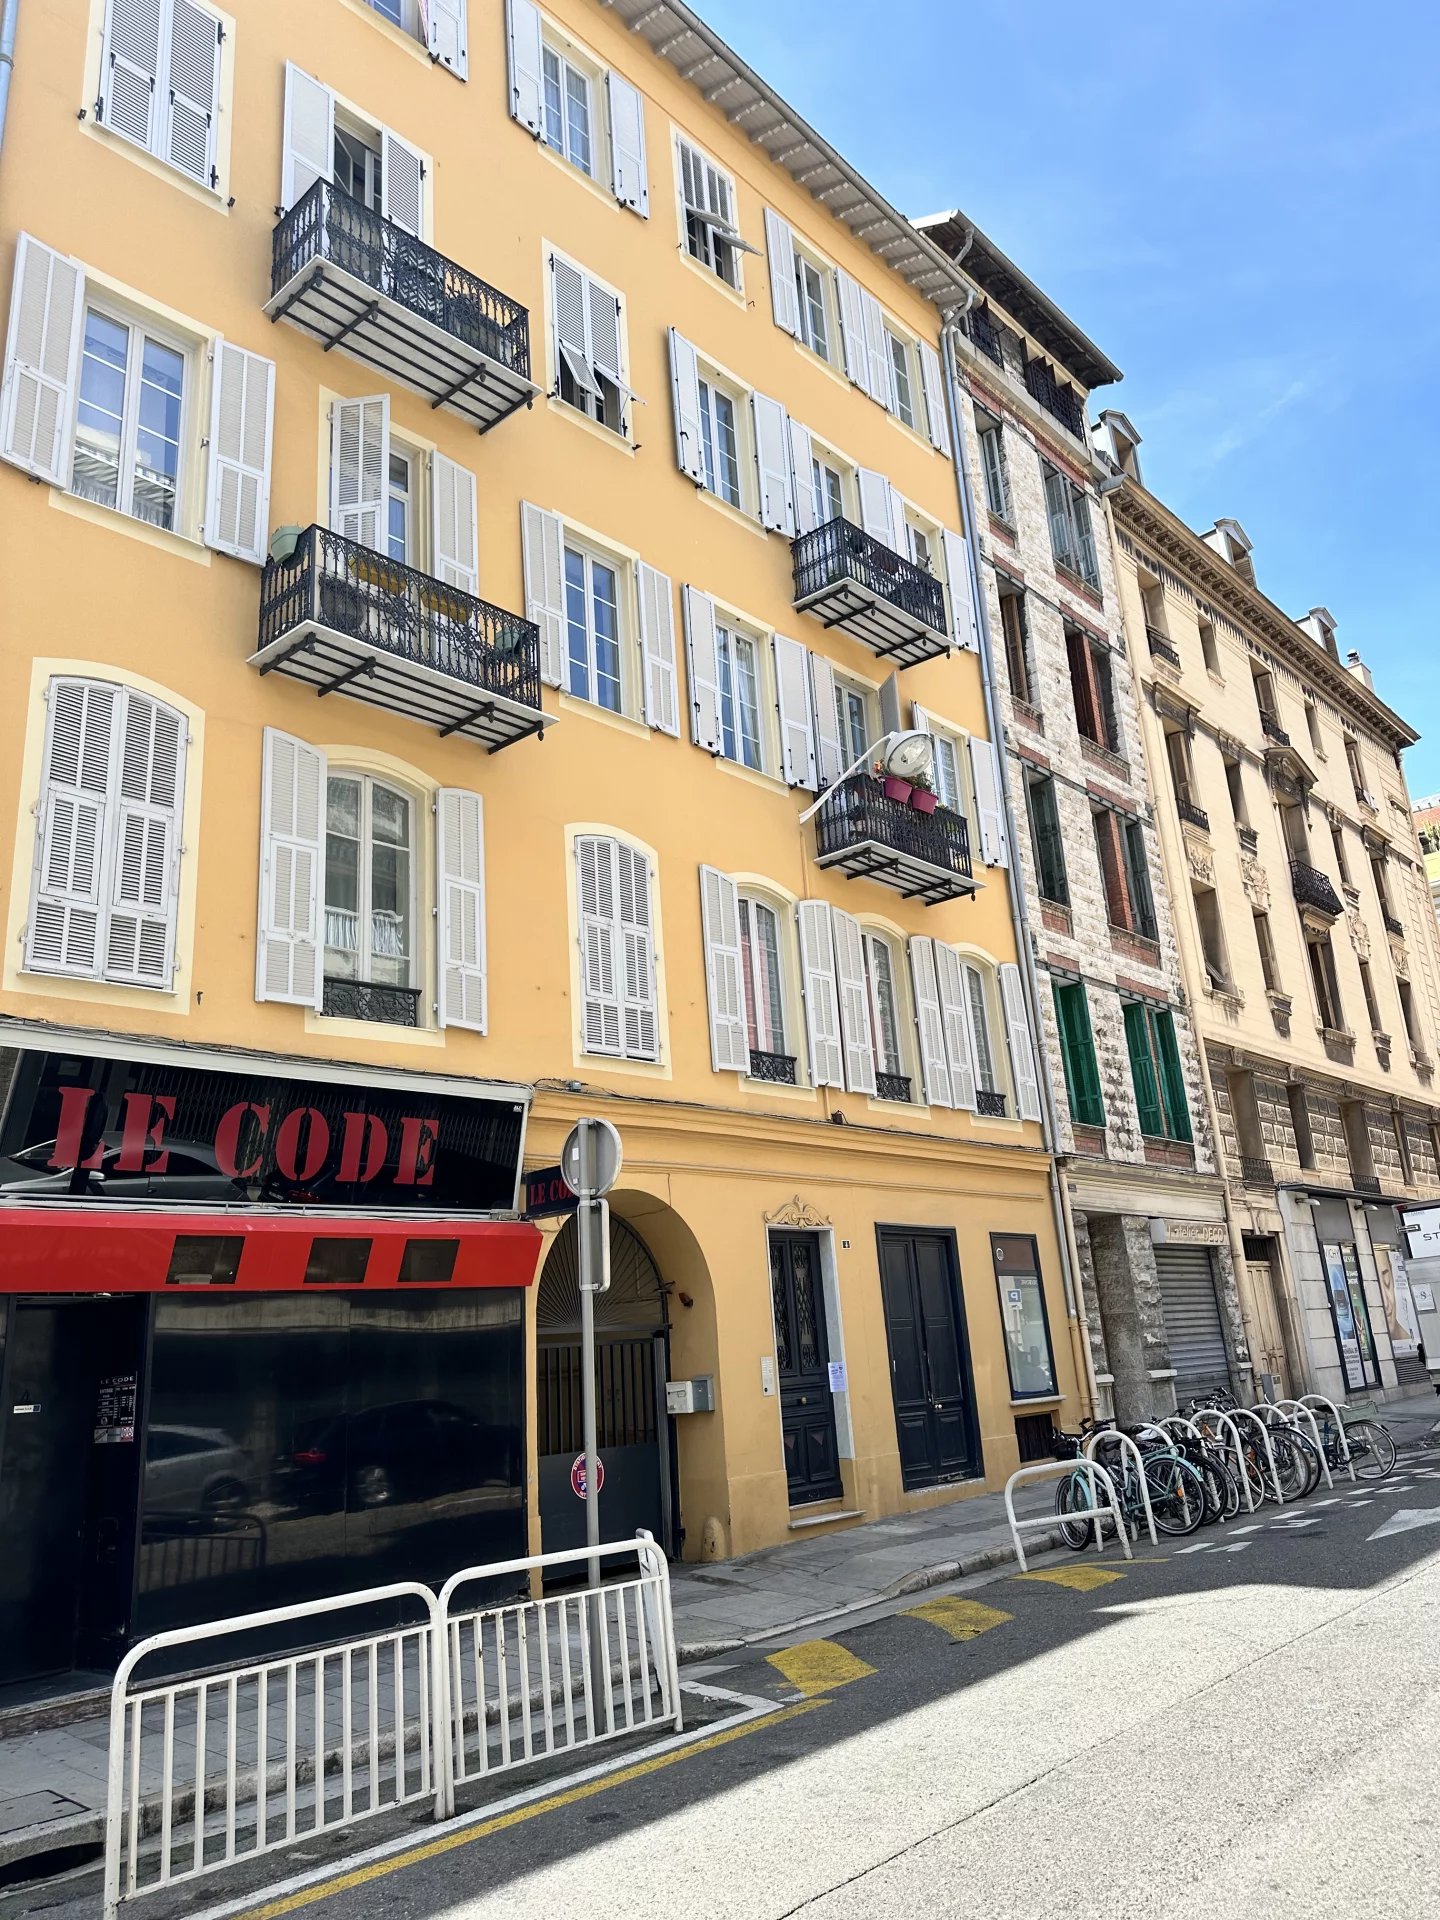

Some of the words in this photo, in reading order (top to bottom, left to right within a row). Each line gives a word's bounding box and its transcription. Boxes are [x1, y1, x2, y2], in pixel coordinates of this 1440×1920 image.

[47, 1086, 177, 1173] LE
[214, 1101, 441, 1186] CODE
[529, 1183, 546, 1206] LE
